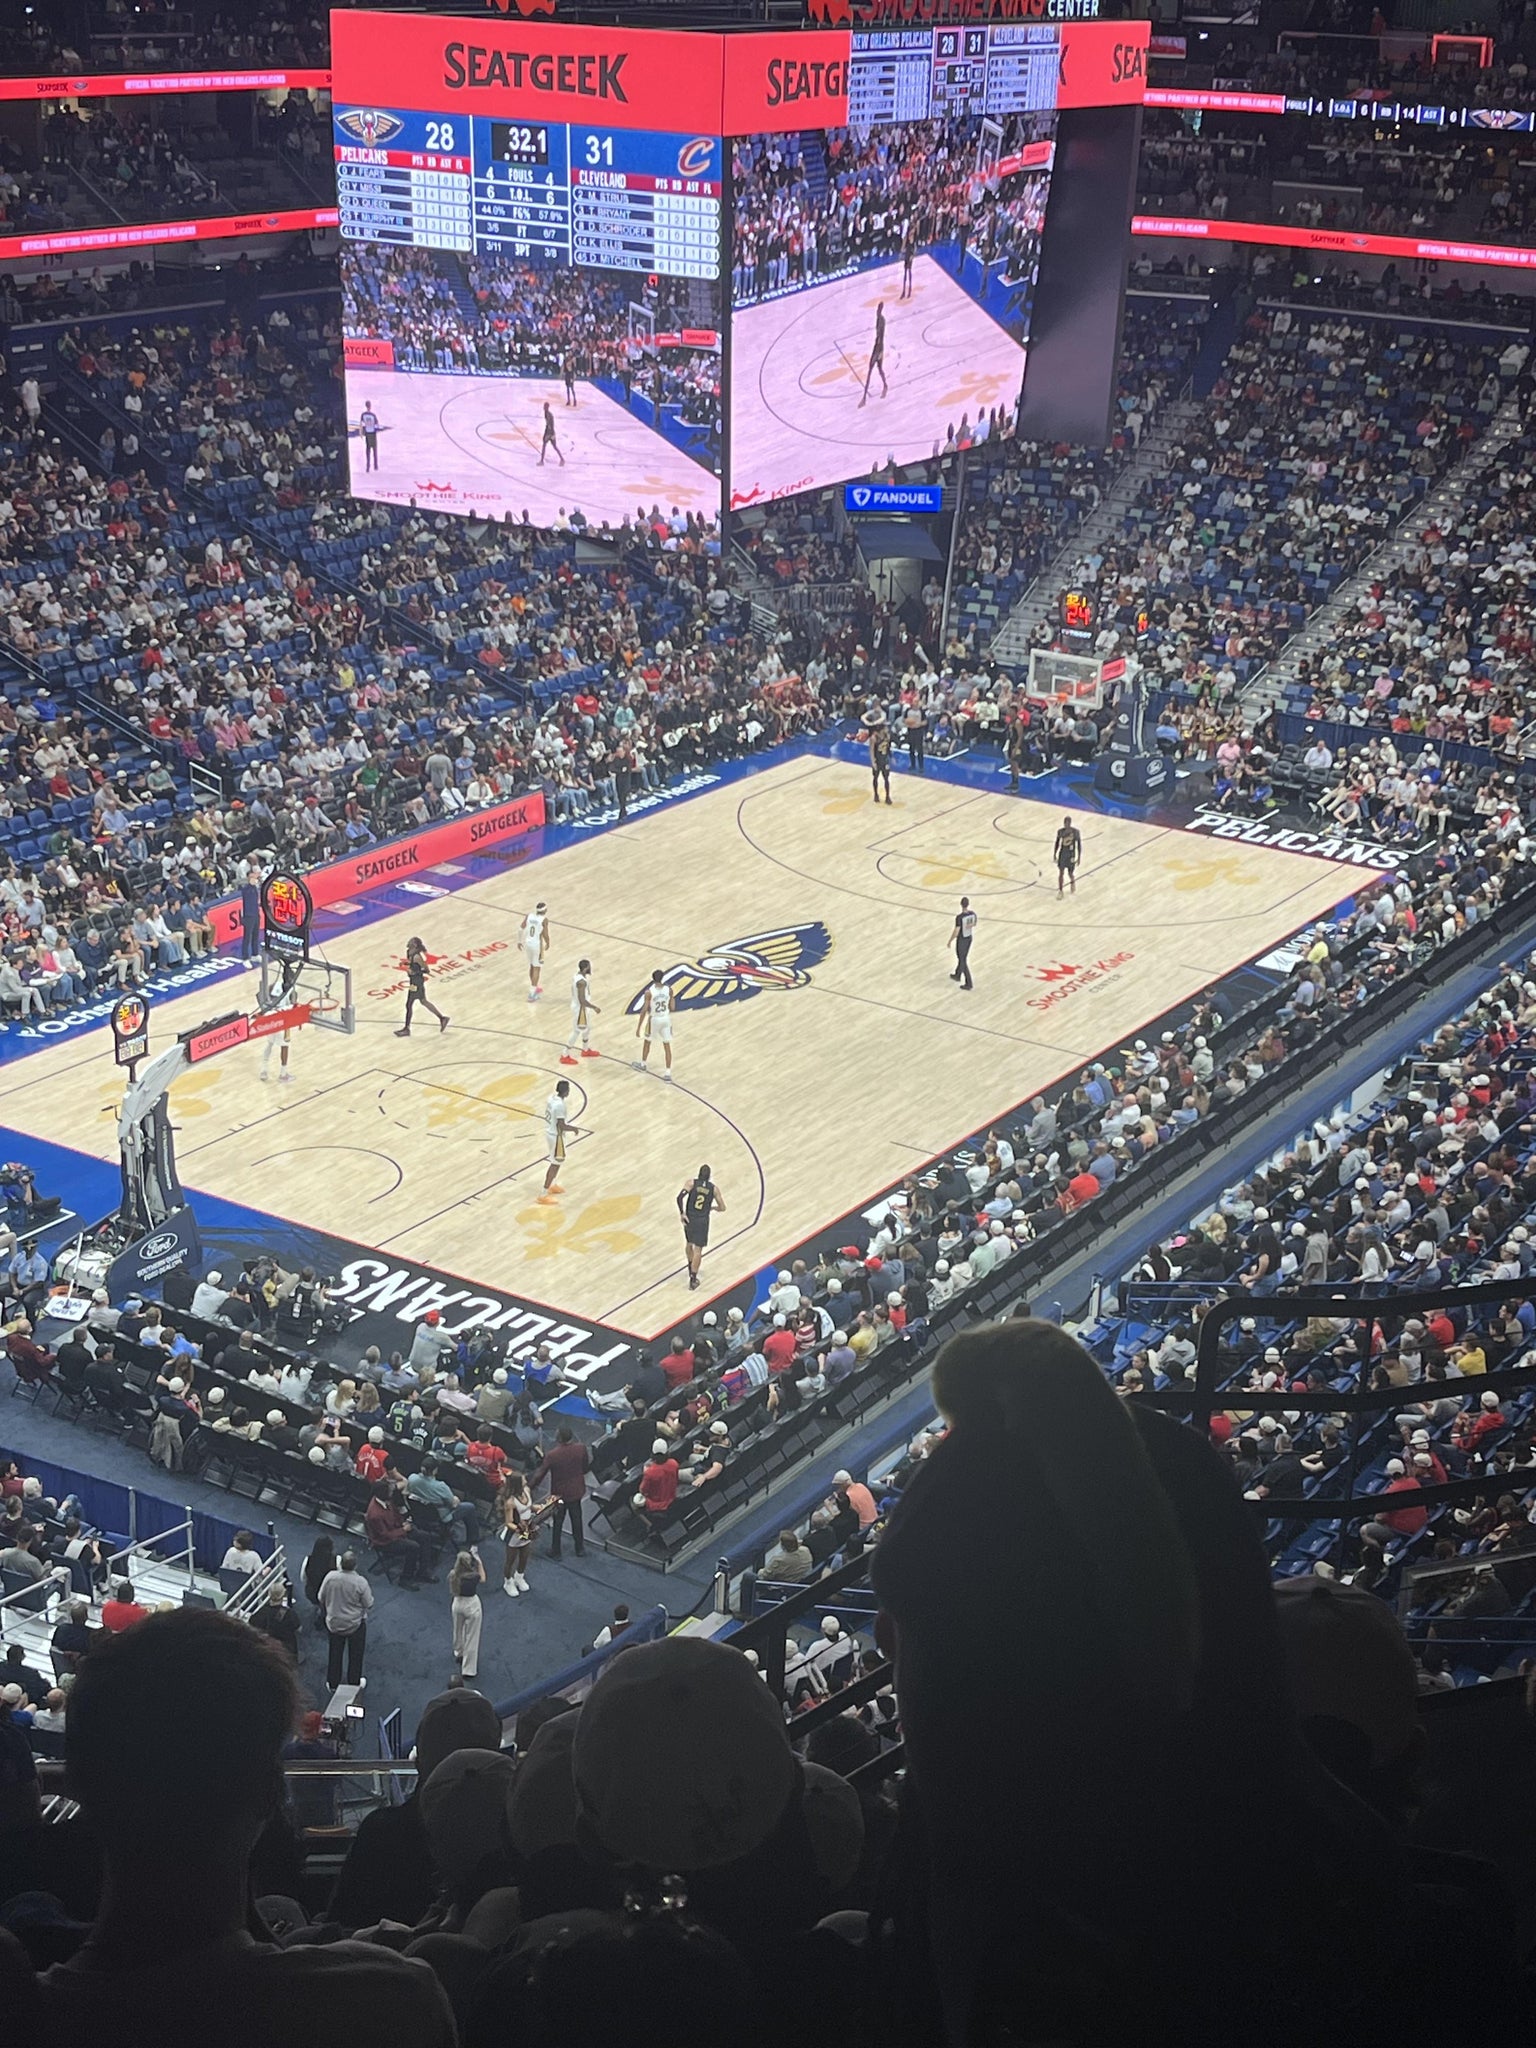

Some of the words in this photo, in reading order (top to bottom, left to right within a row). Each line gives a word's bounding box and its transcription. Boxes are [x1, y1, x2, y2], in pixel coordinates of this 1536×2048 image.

[1048, 0, 1098, 17] CENTER
[853, 34, 869, 49] NEW
[870, 32, 900, 49] ORLEANS
[901, 31, 932, 47] PELICANS
[942, 35, 954, 54] 28
[969, 34, 981, 53] 31
[444, 42, 629, 103] SEATGEEK
[1403, 108, 1415, 120] 14
[425, 121, 455, 152] 28
[508, 126, 547, 154] 32.1
[341, 145, 389, 166] PELICANS
[585, 134, 613, 166] 31
[486, 166, 495, 181] 4
[508, 168, 534, 183] FOULS
[545, 172, 554, 187] 4
[578, 170, 627, 189] CLEVELAND
[655, 178, 668, 190] PTS
[686, 181, 699, 193] AST
[486, 185, 495, 199] 6
[546, 191, 555, 206] 6
[513, 207, 531, 220] FG%
[598, 208, 631, 220] BRYANT
[515, 243, 531, 257] 3PT
[600, 255, 643, 270] MITCHELL
[374, 490, 457, 499] SMOOTHIE
[463, 491, 502, 500] KING
[873, 492, 933, 505] FANDUEL
[1066, 605, 1091, 626] 24
[653, 773, 721, 800] Health
[470, 806, 528, 842] SEATGEEK
[1184, 811, 1410, 869] PELICANS
[356, 845, 419, 884] SEATGEEK
[276, 932, 304, 946] TISSOT
[529, 926, 536, 938] 0
[458, 941, 508, 963] KING
[155, 955, 245, 994] Health
[440, 963, 484, 984] CENTER
[1026, 969, 1103, 1011] SMOOTHIE
[1092, 951, 1135, 973] KING
[655, 1000, 667, 1014] 25
[198, 1024, 241, 1053] SEATGEEK
[694, 1195, 705, 1210] 2
[147, 1237, 172, 1257] Ford
[394, 1416, 403, 1433] 5
[364, 1461, 369, 1476] 1
